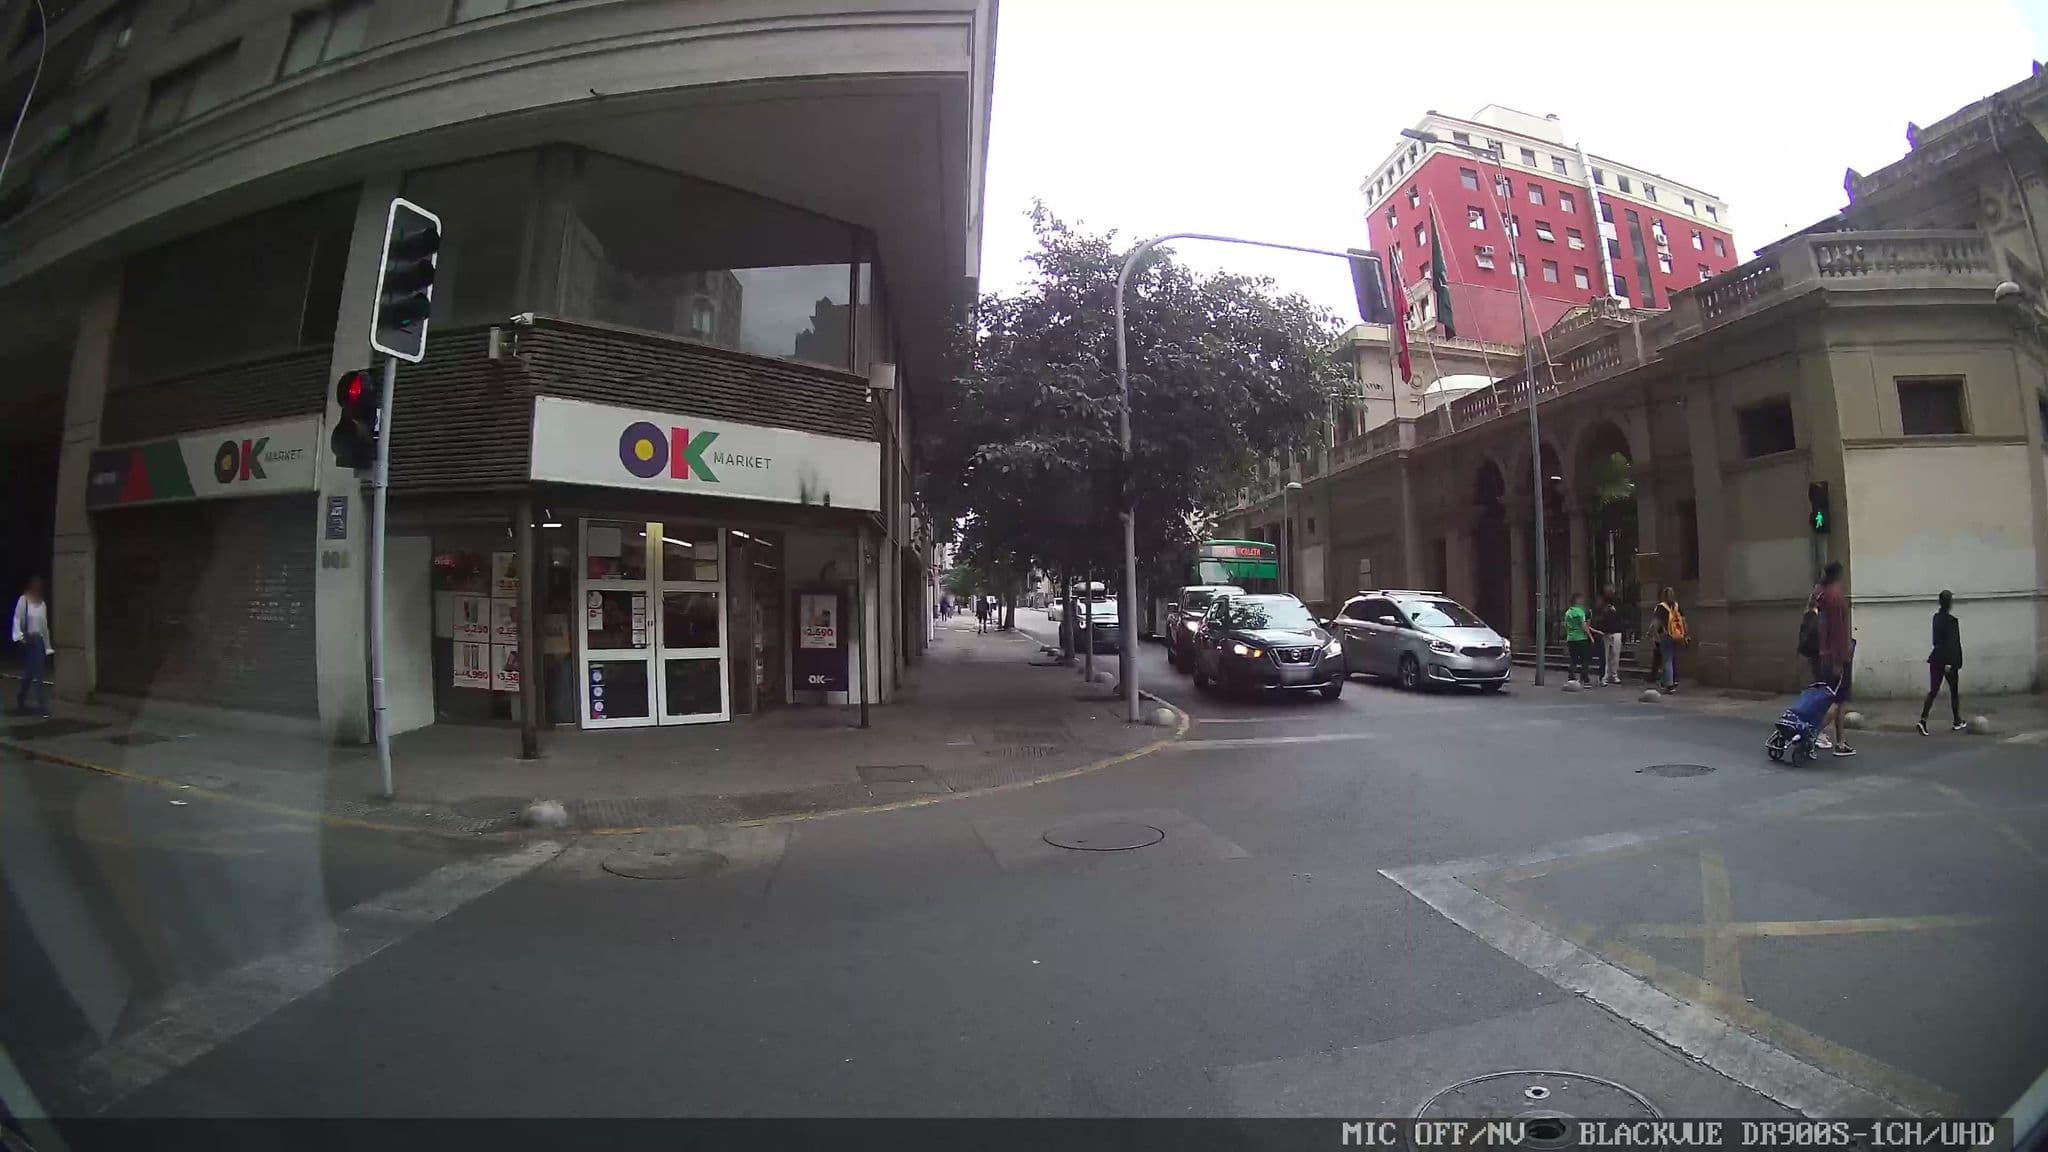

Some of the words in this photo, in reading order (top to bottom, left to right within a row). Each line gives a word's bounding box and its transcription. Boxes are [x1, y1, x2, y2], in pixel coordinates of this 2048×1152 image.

[214, 437, 269, 483] OK
[264, 448, 303, 462] MARKET
[619, 421, 720, 483] OK
[713, 451, 772, 469] MARKET
